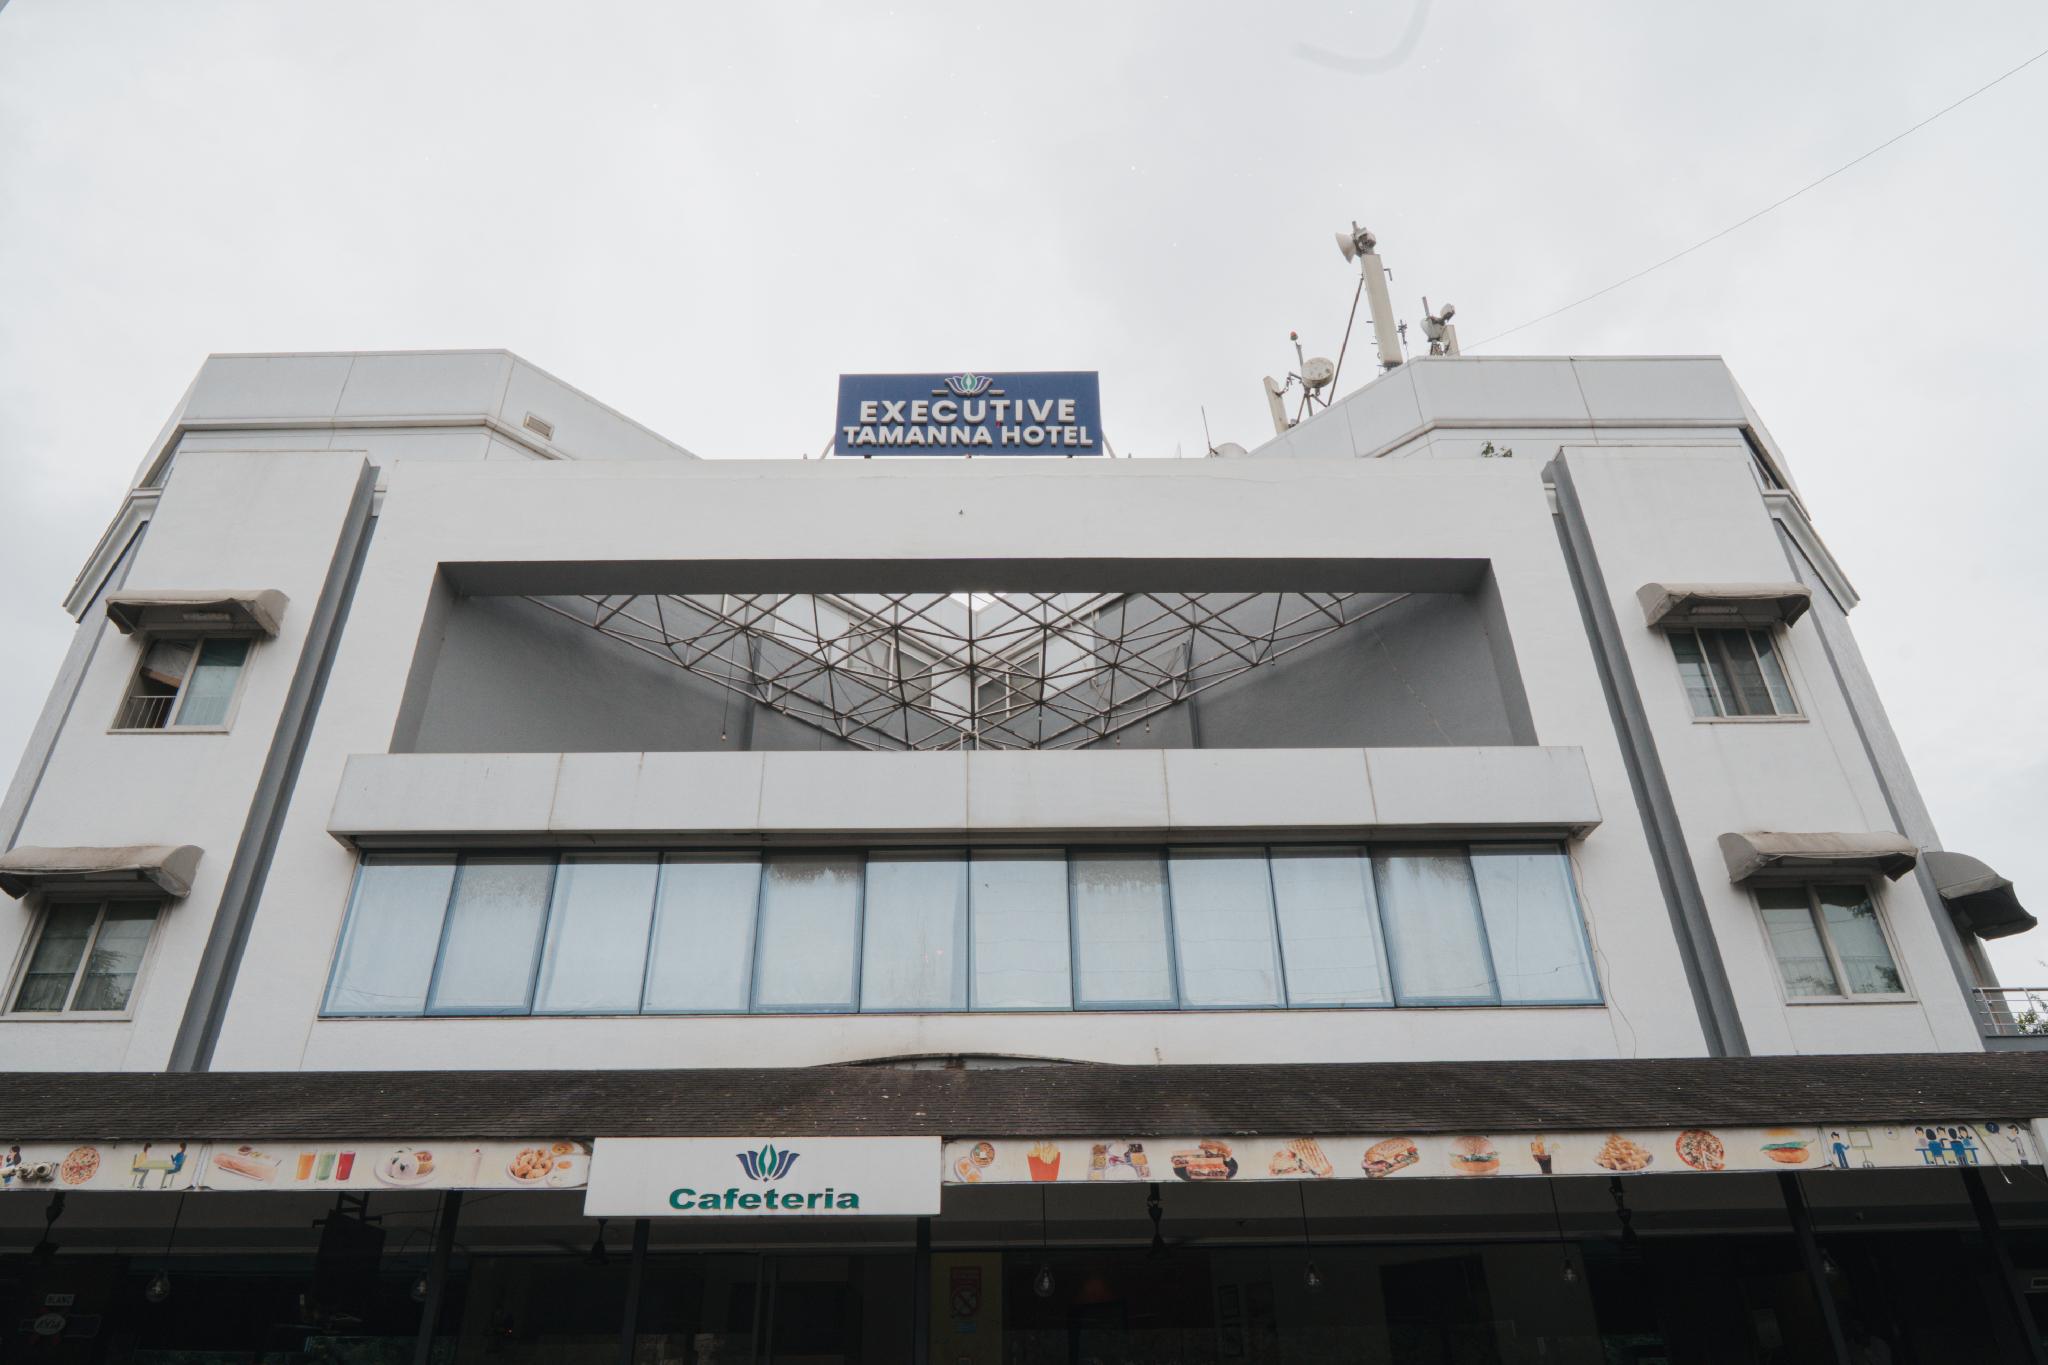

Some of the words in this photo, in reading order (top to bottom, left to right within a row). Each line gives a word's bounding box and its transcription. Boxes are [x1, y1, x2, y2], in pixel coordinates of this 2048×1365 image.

[860, 398, 1076, 424] EXECUTIVE
[843, 425, 993, 447] TAMANNA
[1001, 424, 1093, 446] HOTEL
[669, 1188, 860, 1210] Cafeteria
